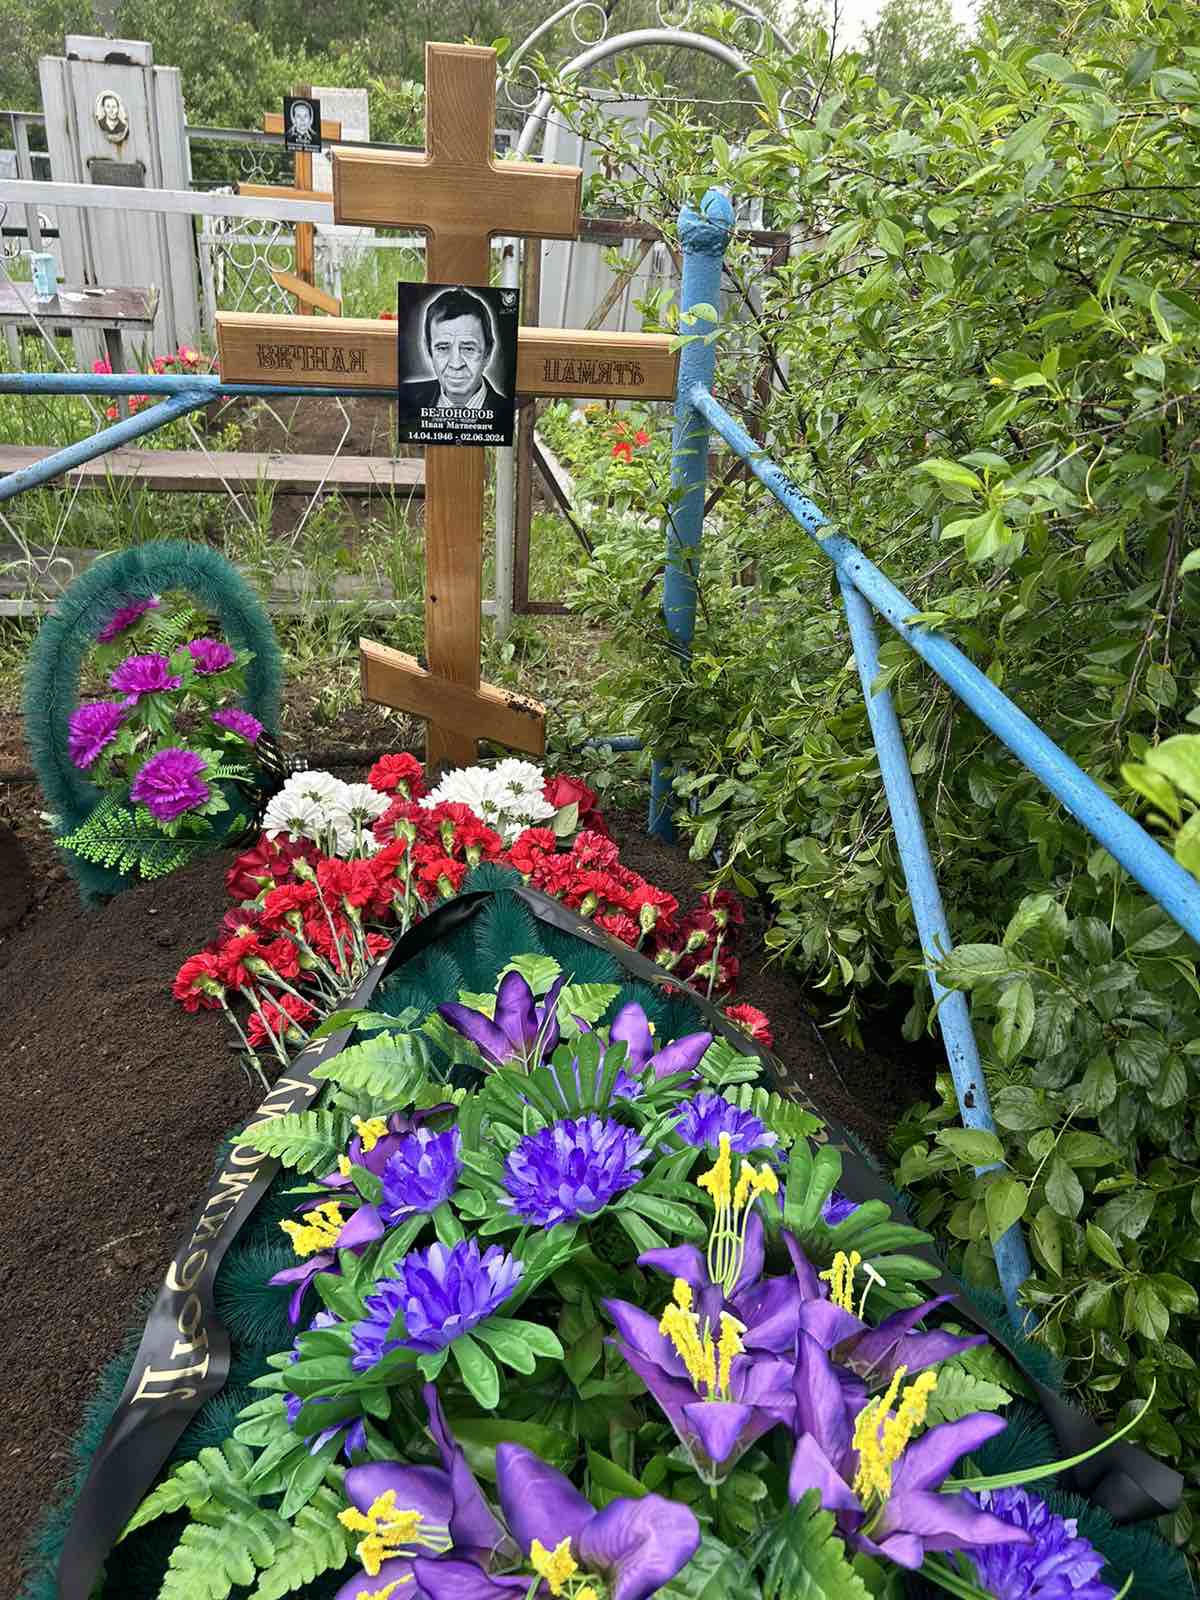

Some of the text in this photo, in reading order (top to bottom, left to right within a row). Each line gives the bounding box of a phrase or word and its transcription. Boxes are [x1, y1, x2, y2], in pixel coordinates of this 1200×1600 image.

[420, 407, 495, 419] БЕЛОНОГОВ
[421, 420, 444, 429] Иван
[446, 421, 494, 430] Матвеевич
[460, 433, 505, 442] 02.06.2024
